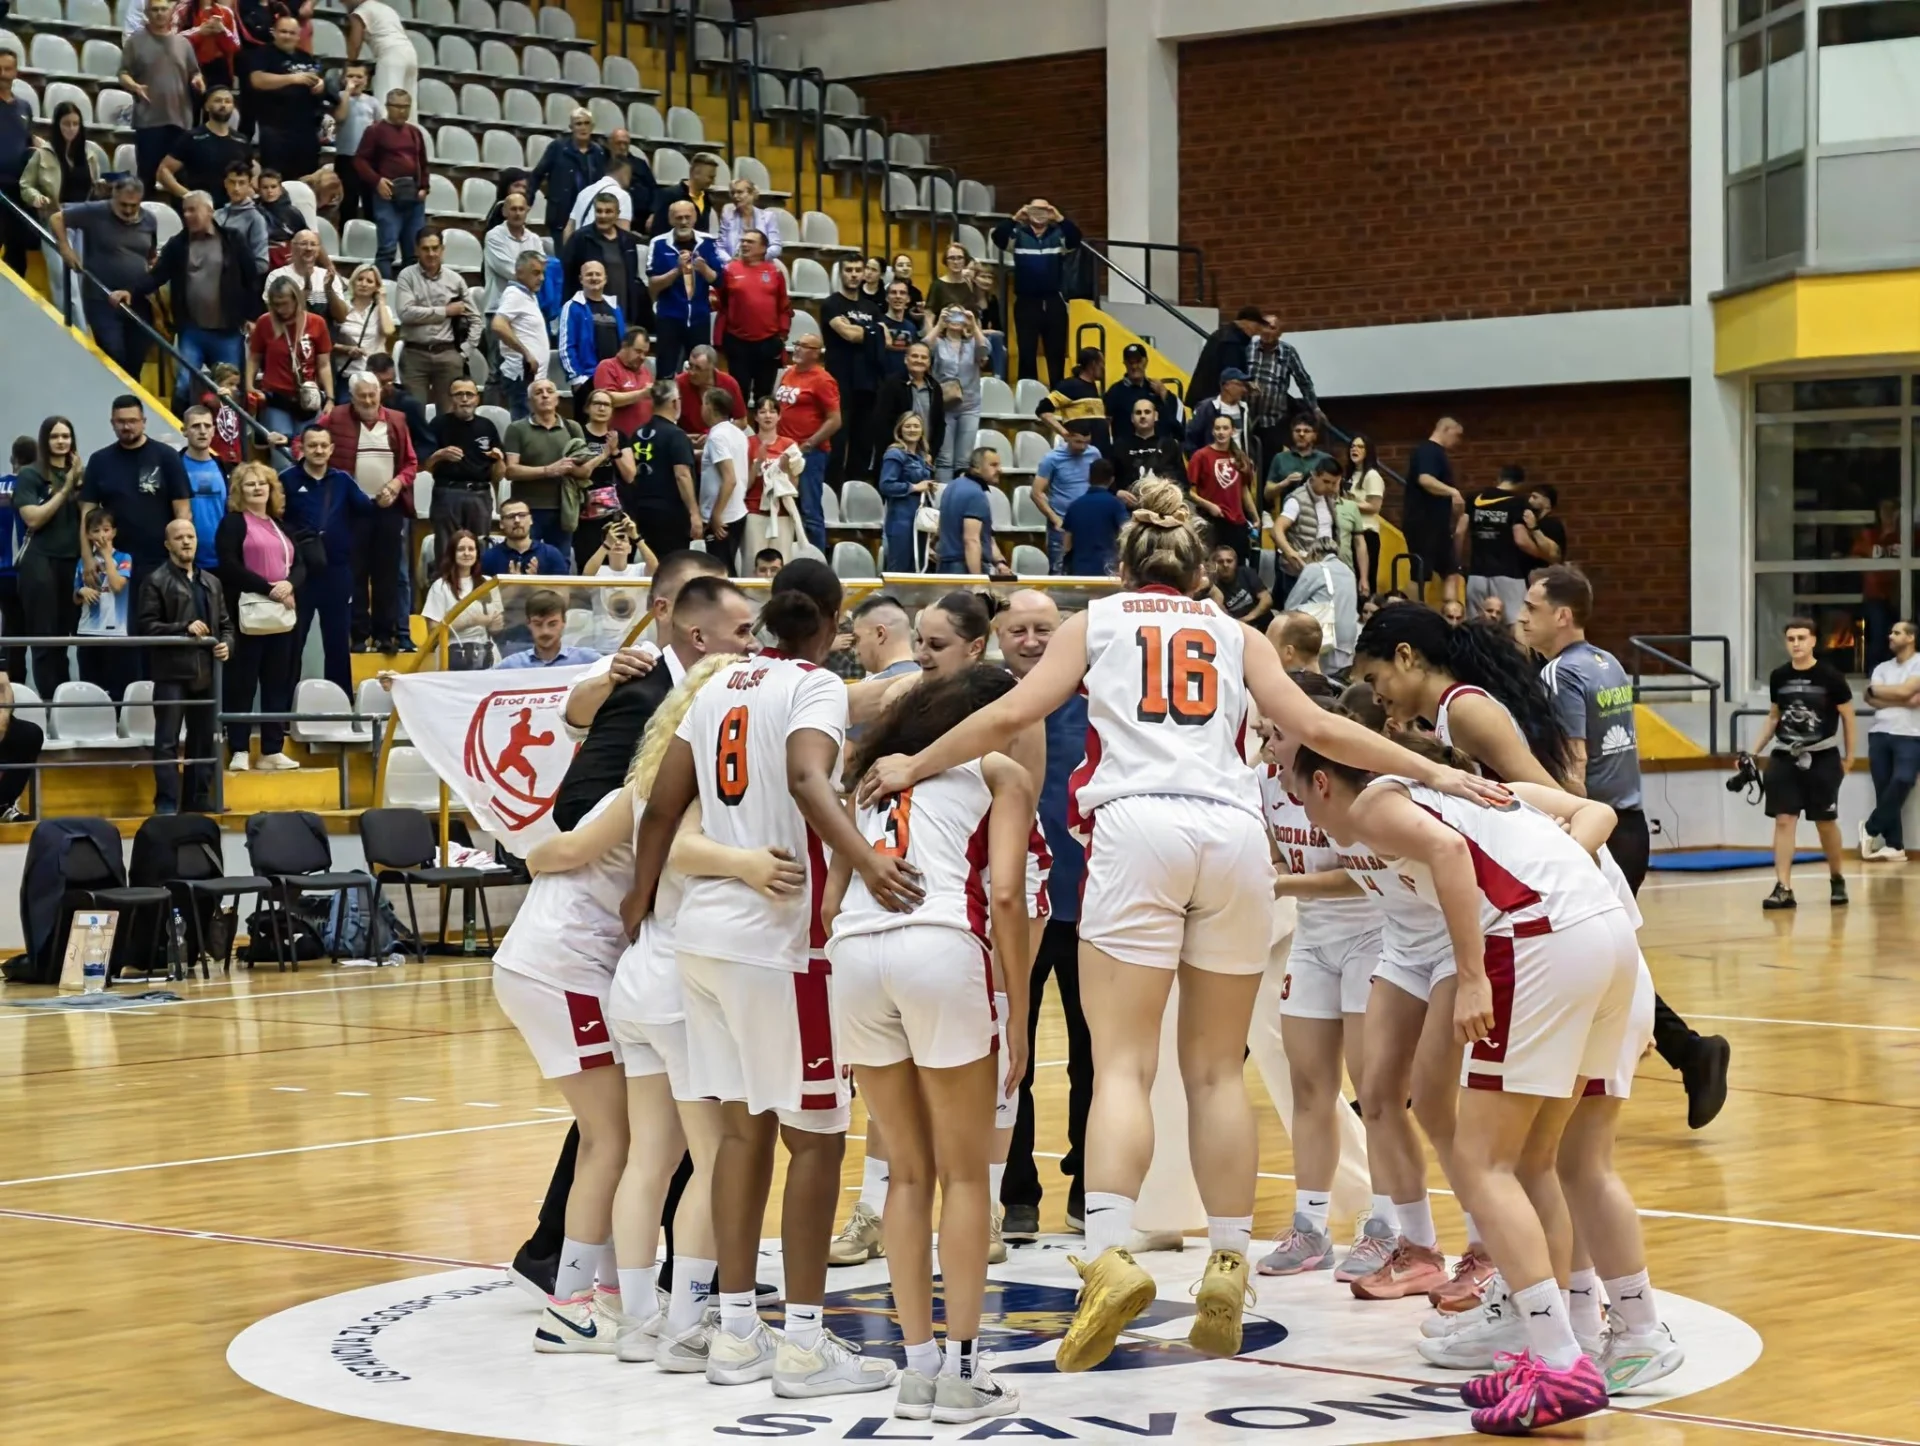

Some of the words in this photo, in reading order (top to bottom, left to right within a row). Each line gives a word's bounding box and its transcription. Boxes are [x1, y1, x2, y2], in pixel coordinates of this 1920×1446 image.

[1136, 625, 1218, 726] 16
[494, 697, 525, 706] Brod
[716, 705, 749, 807] 8
[1288, 848, 1305, 874] 13
[1362, 875, 1384, 897] 4
[339, 1324, 390, 1336] ZA
[331, 1336, 412, 1384] USTANOVA
